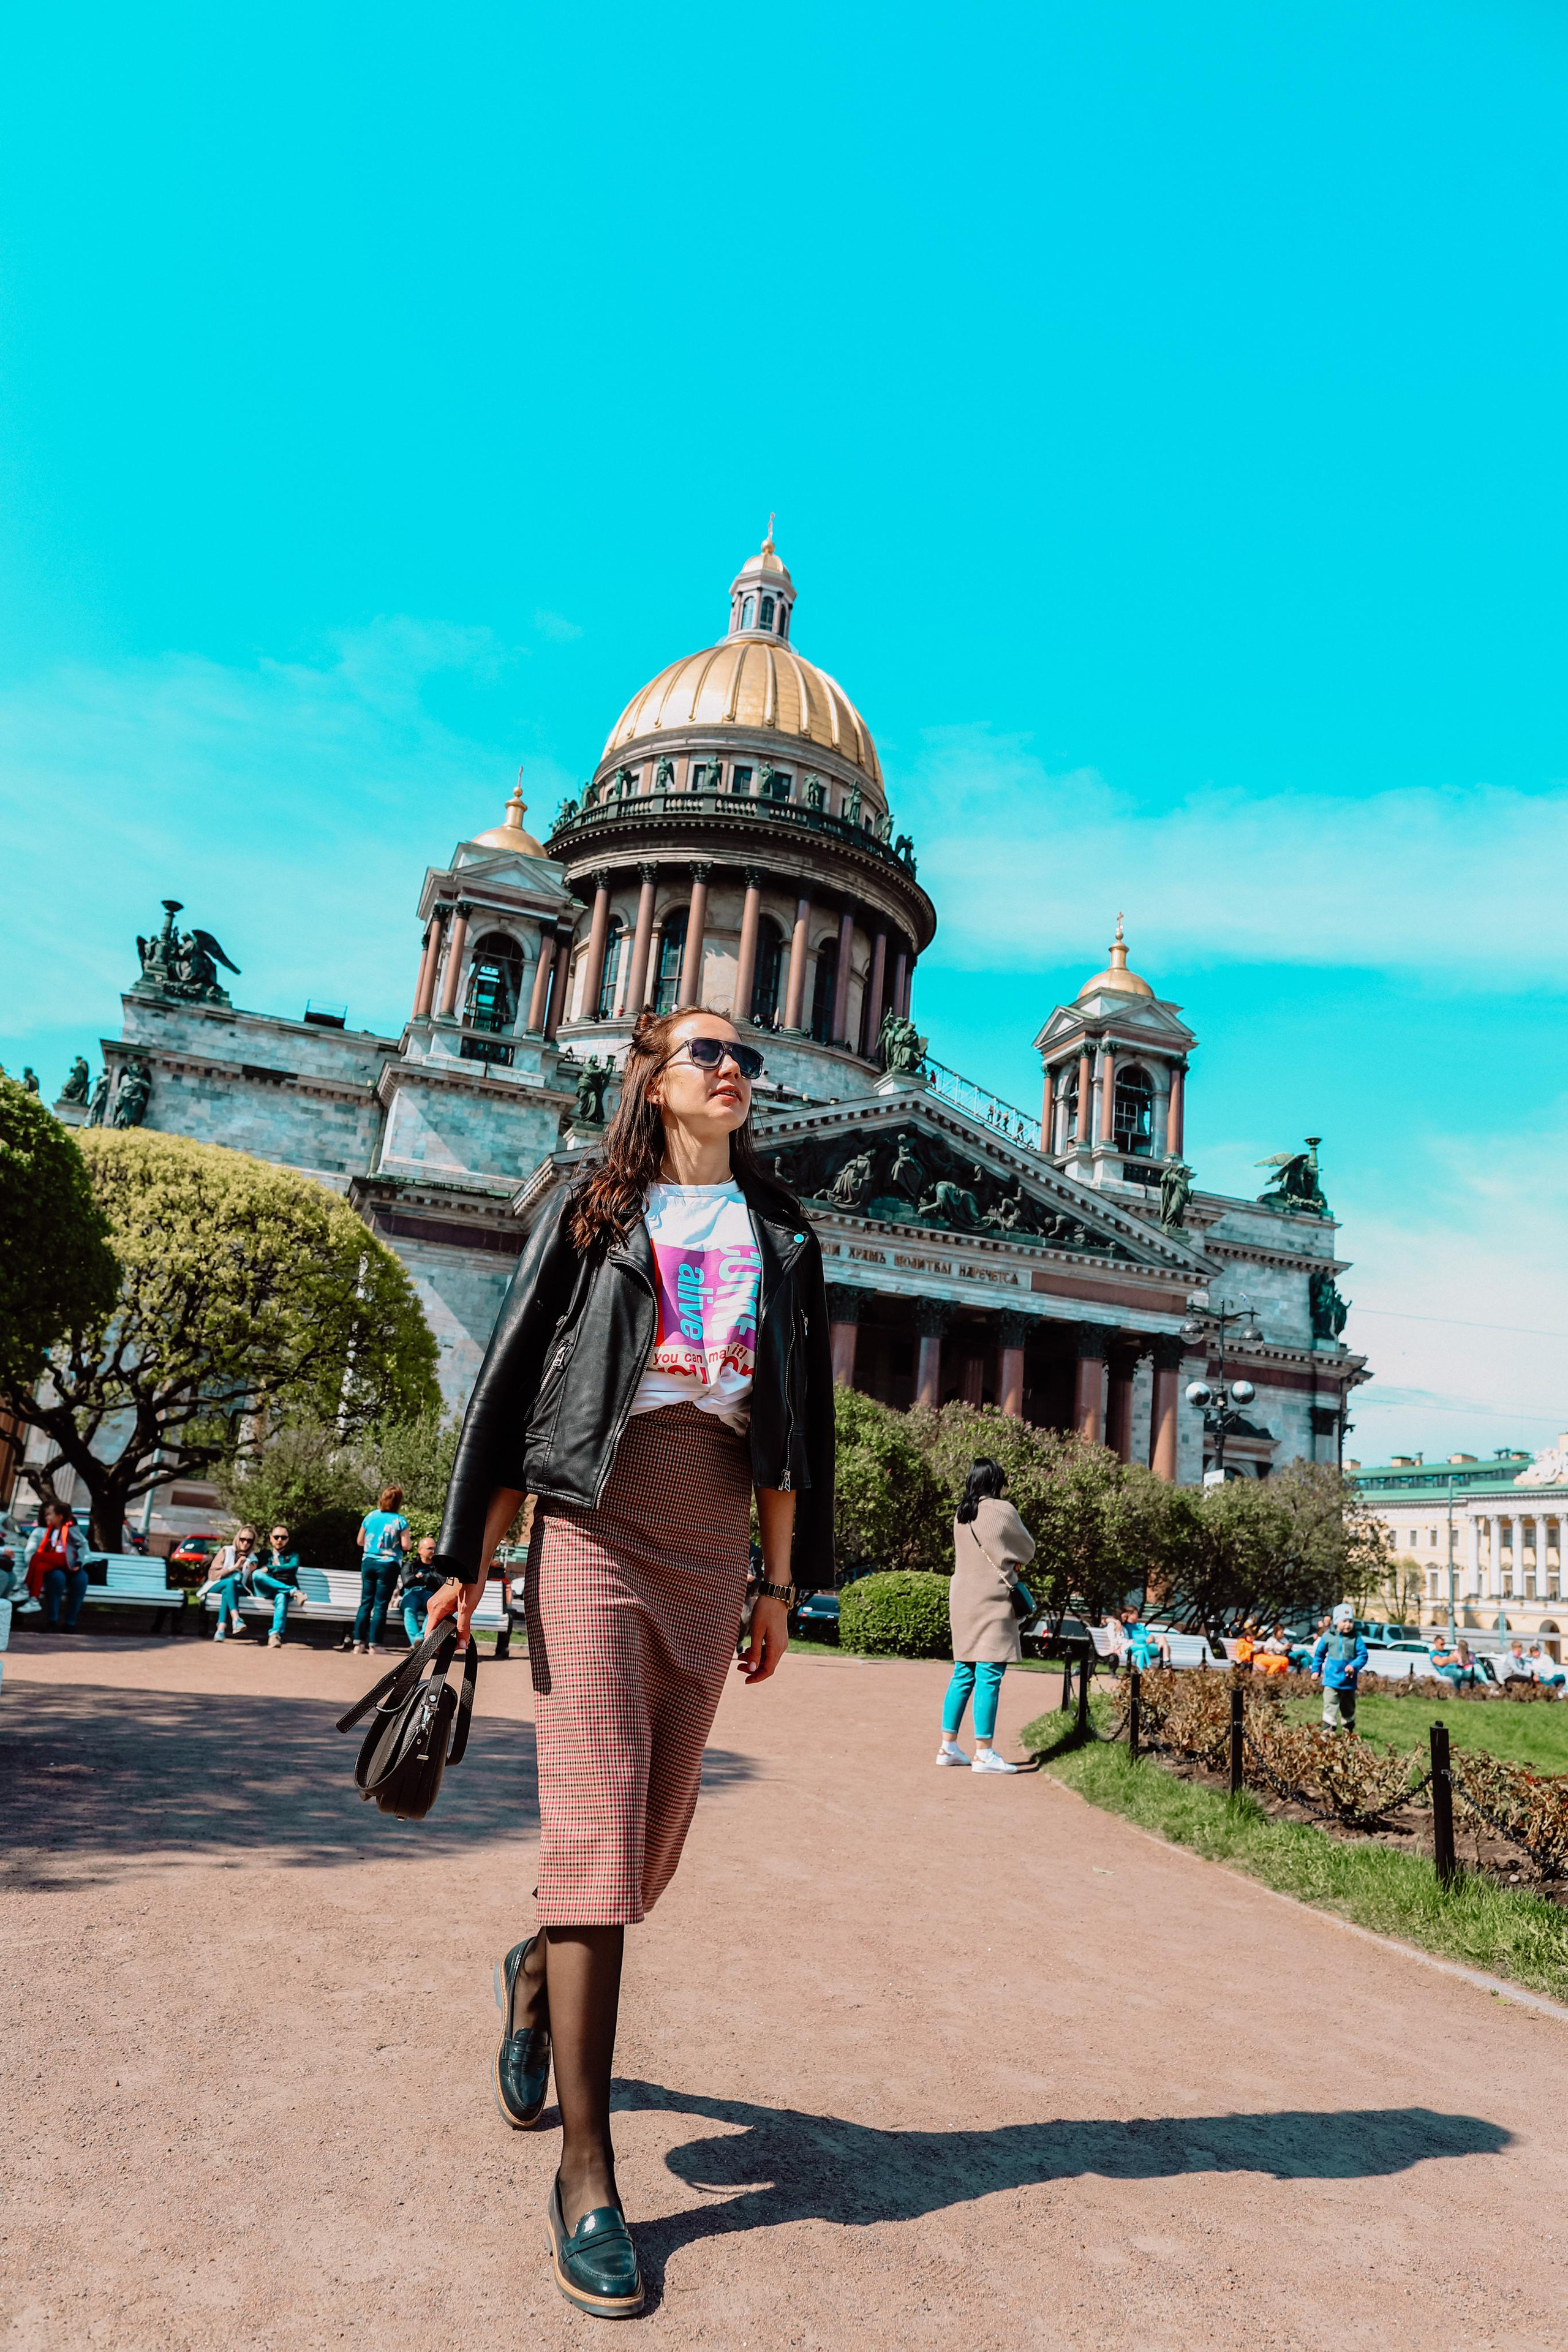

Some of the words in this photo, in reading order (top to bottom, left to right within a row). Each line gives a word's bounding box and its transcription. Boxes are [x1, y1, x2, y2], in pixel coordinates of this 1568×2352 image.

[678, 1263, 714, 1341] alive
[653, 1353, 679, 1365] you
[684, 1352, 703, 1363] can
[731, 1344, 748, 1360] it!
